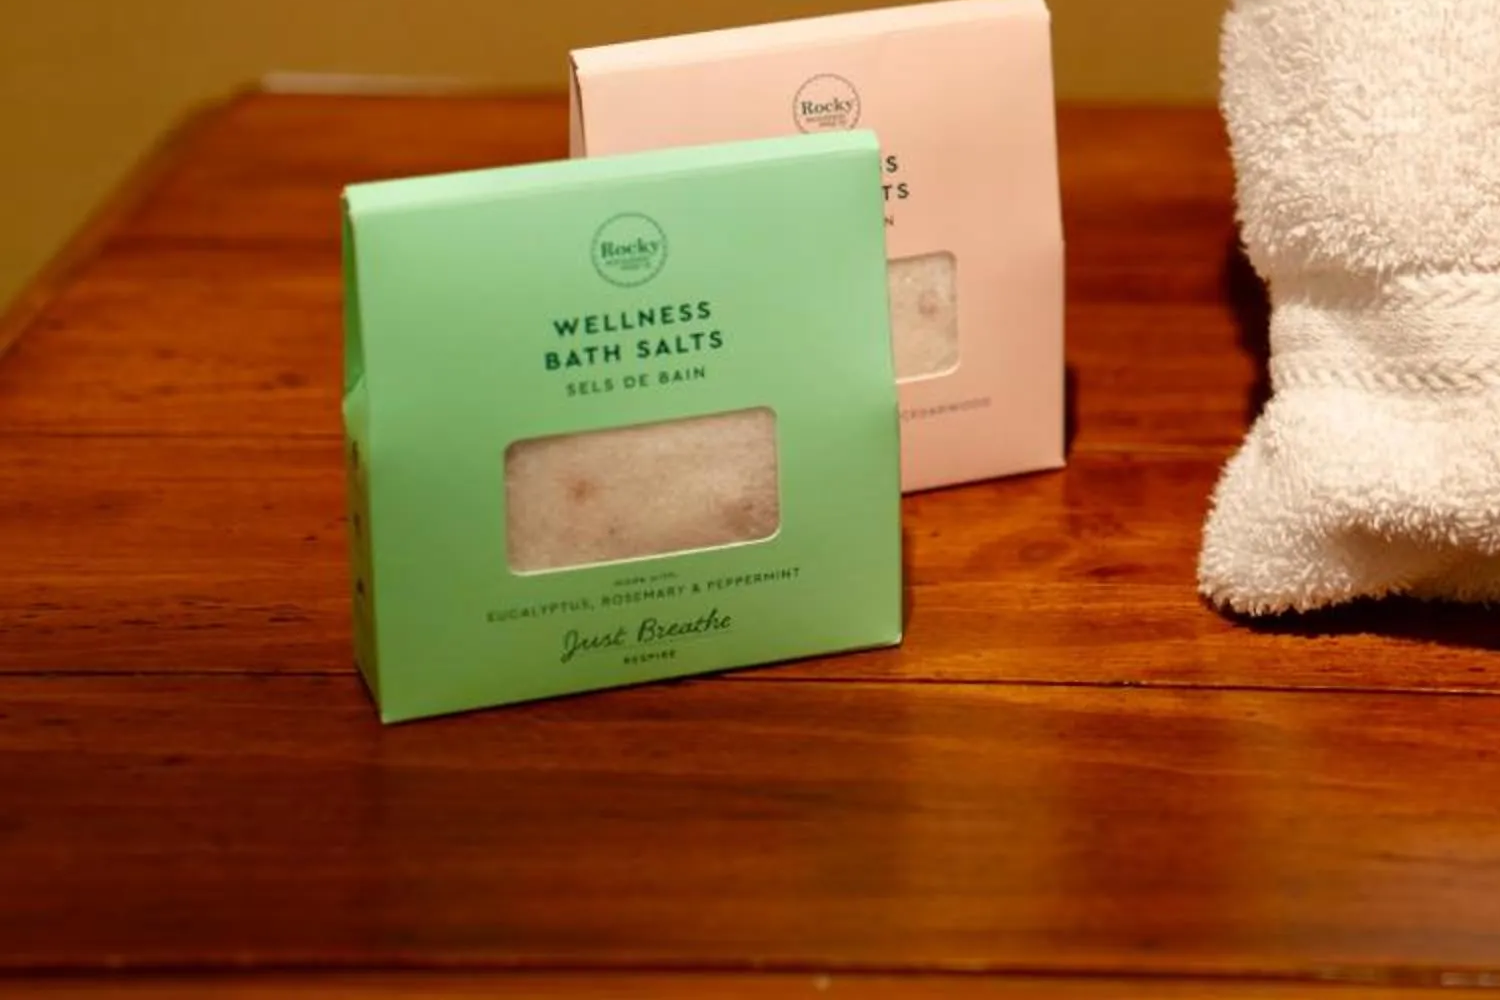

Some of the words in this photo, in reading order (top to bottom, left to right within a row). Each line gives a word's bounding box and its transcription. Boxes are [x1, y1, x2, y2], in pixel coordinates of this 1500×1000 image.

[800, 98, 854, 116] Rocky
[601, 237, 660, 258] Rocky
[553, 301, 712, 337] WELLNESS
[545, 344, 621, 371] BATH
[637, 331, 723, 359] SALTS
[566, 378, 614, 397] SELS
[624, 374, 650, 389] DE
[659, 366, 706, 385] BAIN
[486, 598, 594, 623] EUCALYPTUS,
[601, 585, 685, 606] ROSEMARY
[707, 567, 800, 592] PEPPERMINT
[560, 627, 627, 663] Just
[637, 607, 732, 643] Breathe
